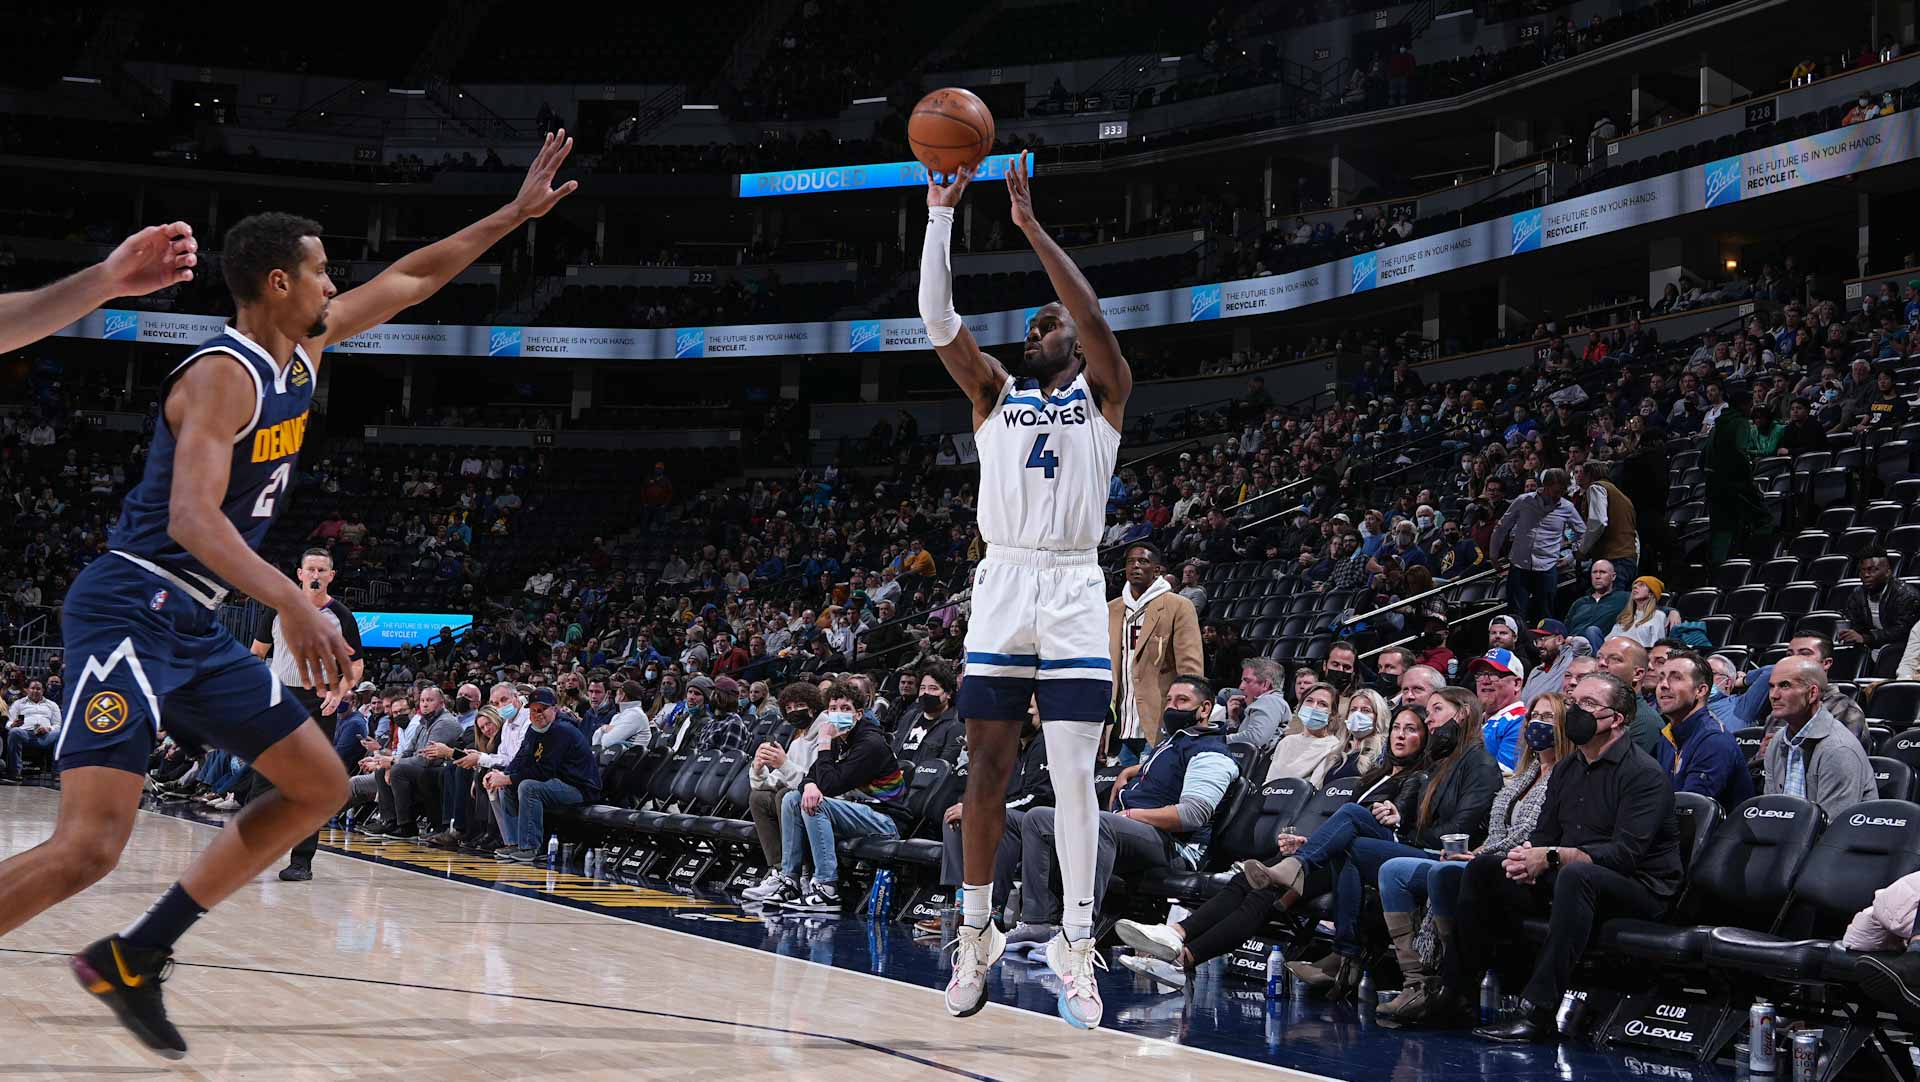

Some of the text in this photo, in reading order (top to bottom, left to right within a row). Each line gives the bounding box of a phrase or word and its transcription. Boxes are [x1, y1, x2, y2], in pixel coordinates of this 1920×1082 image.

[1750, 106, 1771, 121] 228
[1104, 125, 1122, 135] 333
[1748, 165, 1763, 177] THE
[1766, 155, 1799, 171] FUTURE
[1801, 152, 1809, 163] IS
[1811, 150, 1821, 161] IN
[1822, 143, 1847, 157] YOUR
[758, 168, 867, 194] PRODUCED
[1747, 169, 1798, 190] RECYCLE IT.
[1547, 216, 1561, 226] THE
[1562, 209, 1589, 223] FUTURE
[1590, 206, 1597, 215] IS
[1598, 203, 1606, 213] IN
[1608, 198, 1628, 210] YOUR
[1546, 221, 1589, 239] RECYCLE IT.
[1394, 252, 1417, 265] FUTURE
[1424, 248, 1431, 257] IN
[1432, 245, 1449, 256] YOUR
[693, 273, 712, 282] 222
[1380, 264, 1416, 279] RECYCLE IT.
[1226, 292, 1240, 301] THE
[1241, 289, 1268, 299] FUTURE
[1269, 288, 1276, 296] IS
[1276, 287, 1284, 295] IN
[1226, 299, 1267, 311] RECYCLE IT.
[145, 321, 159, 330] THE
[161, 322, 189, 331] FUTURE
[200, 323, 208, 331] IN
[209, 323, 225, 332] YOU
[143, 331, 188, 339] RECYCLE IT.
[401, 334, 420, 342] YOUR
[885, 337, 927, 346] RECYCLE IT.
[340, 341, 374, 350] RECYCLE
[708, 344, 737, 352] RECYCLE
[1003, 405, 1086, 429] WOLVES
[1025, 433, 1060, 479] 4
[381, 630, 419, 639] RECYCLE IT.
[1758, 809, 1796, 820] LEXUS
[1865, 817, 1907, 827] LEXUS
[1232, 957, 1267, 971] LEXUS
[1655, 1004, 1687, 1019] CLUB
[1643, 1026, 1694, 1042] LEXUS
